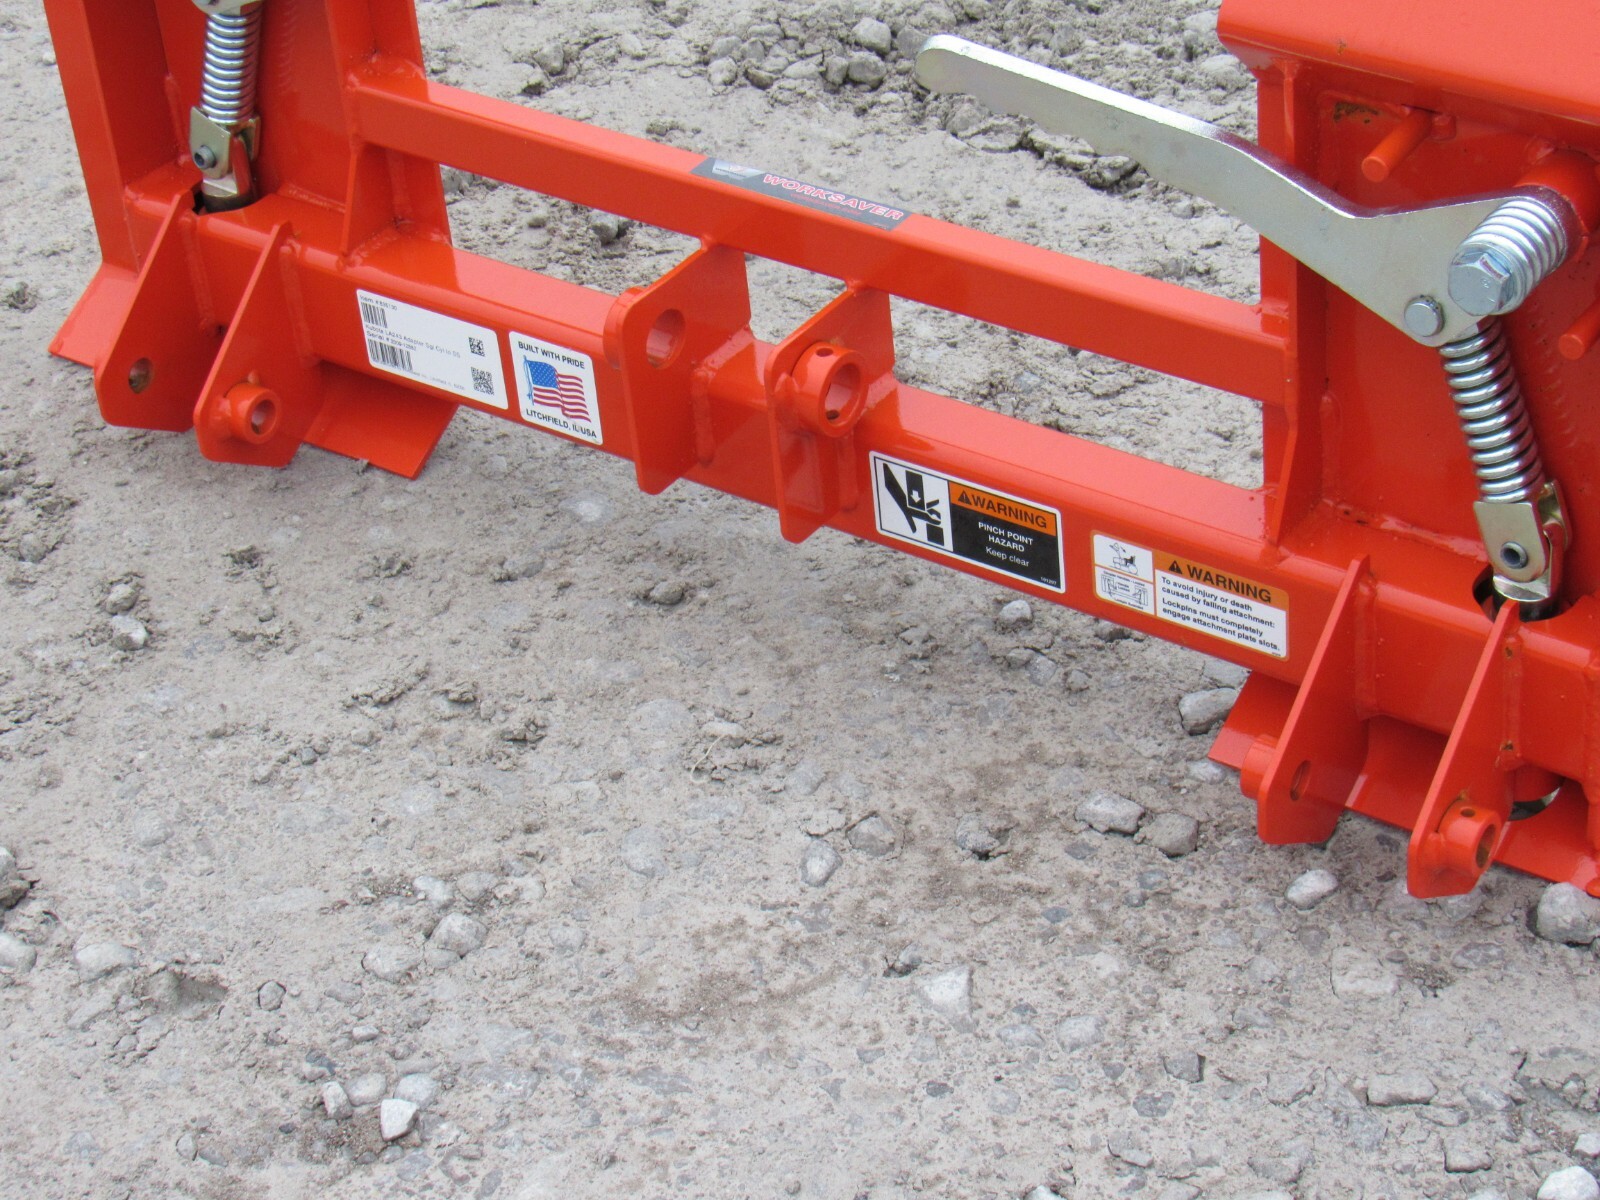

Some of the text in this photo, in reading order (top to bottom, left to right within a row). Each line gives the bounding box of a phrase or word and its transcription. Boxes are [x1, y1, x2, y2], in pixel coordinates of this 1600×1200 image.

[763, 173, 904, 220] WORKSAVER
[367, 330, 385, 341] Serial
[518, 341, 585, 369] BUILT WITH PRIDE
[526, 408, 571, 430] LITCHFIELD,
[580, 426, 597, 438] USA
[972, 495, 1047, 529] WARNING
[978, 521, 1033, 546] PINCH POINT
[988, 535, 1025, 552] HAZARD
[986, 546, 1030, 567] Keep clear
[1161, 576, 1170, 585] To
[1173, 580, 1194, 593] avoid
[1196, 586, 1218, 602] injury
[1230, 597, 1252, 611] death
[1187, 564, 1271, 603] WARNING
[1162, 587, 1275, 629] caused by falling attachment:
[1162, 597, 1263, 637] Lockpins must completely
[1163, 608, 1280, 652] engage attachment plate slots.
